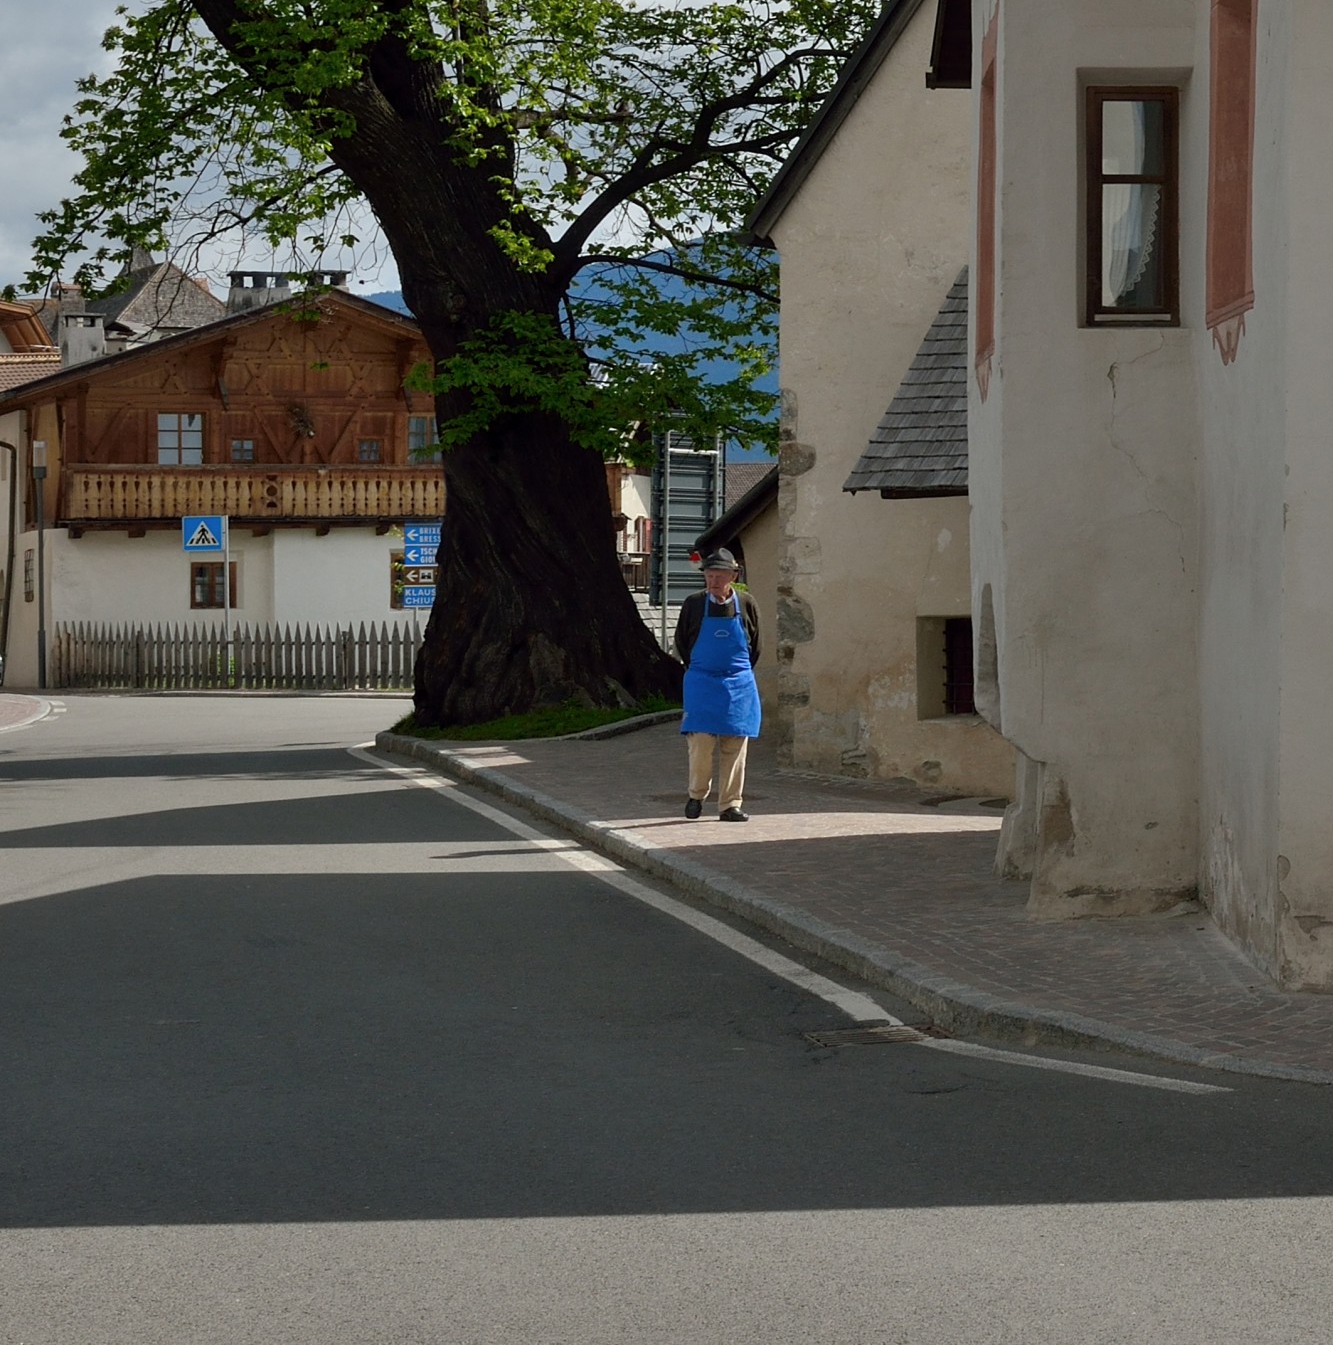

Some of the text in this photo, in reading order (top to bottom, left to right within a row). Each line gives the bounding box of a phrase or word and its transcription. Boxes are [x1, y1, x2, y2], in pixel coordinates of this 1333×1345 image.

[419, 527, 441, 535] BRIXE
[419, 535, 441, 543] BRESS
[405, 588, 436, 596] KLAUS
[405, 597, 435, 605] CHIUS
